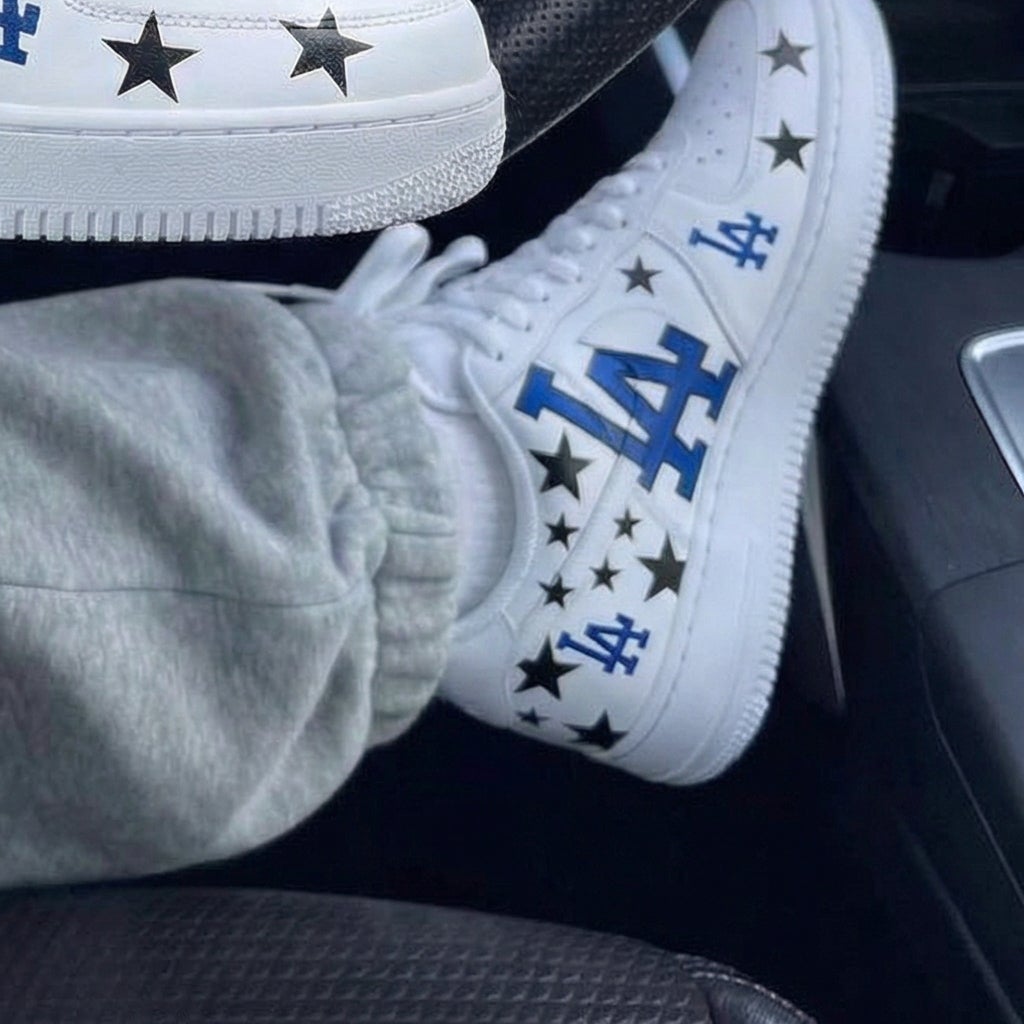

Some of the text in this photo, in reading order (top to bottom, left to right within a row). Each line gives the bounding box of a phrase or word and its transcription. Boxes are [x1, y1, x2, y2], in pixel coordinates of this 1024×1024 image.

[688, 211, 779, 271] LA
[514, 324, 742, 502] LA
[555, 612, 651, 676] LA
